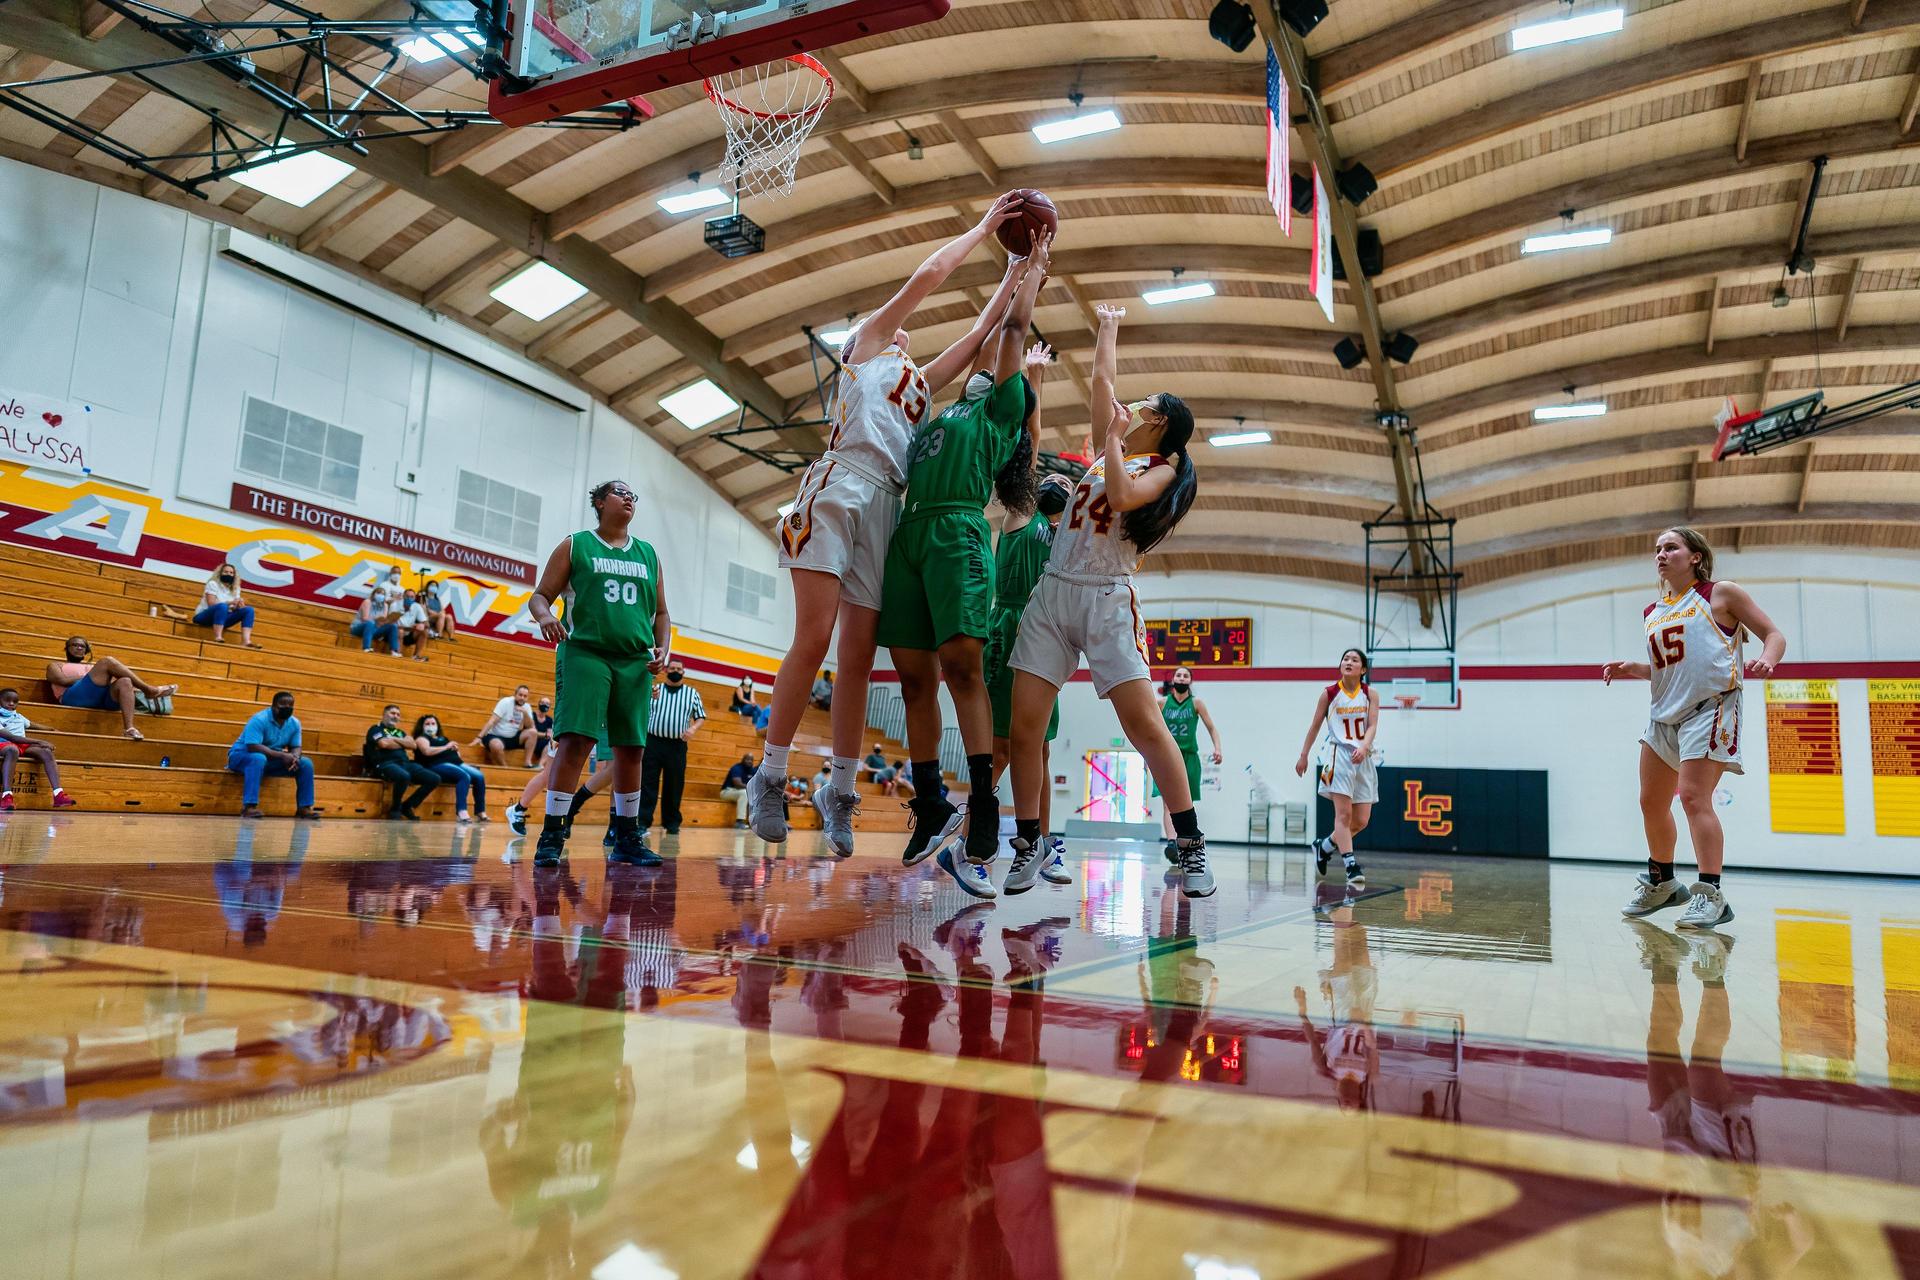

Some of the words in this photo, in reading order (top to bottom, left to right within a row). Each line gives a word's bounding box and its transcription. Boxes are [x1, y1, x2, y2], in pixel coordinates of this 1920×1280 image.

[887, 364, 927, 425] 13
[0, 398, 25, 419] We
[0, 425, 84, 468] ALYSSA
[914, 427, 946, 464] 23
[1068, 483, 1113, 536] 24
[249, 490, 287, 516] THE
[291, 503, 385, 541] HOTCHKIN
[389, 528, 441, 555] FAMILY
[443, 544, 526, 579] GYMNASIUM
[592, 557, 648, 580] MONROVIA
[603, 579, 638, 605] 30
[1179, 621, 1207, 634] 2:27
[1228, 631, 1245, 644] 20
[1649, 624, 1685, 670] 15
[1871, 683, 1897, 691] BOYS
[1169, 723, 1188, 736] 22
[1343, 717, 1365, 740] 10
[1404, 780, 1453, 836] LC
